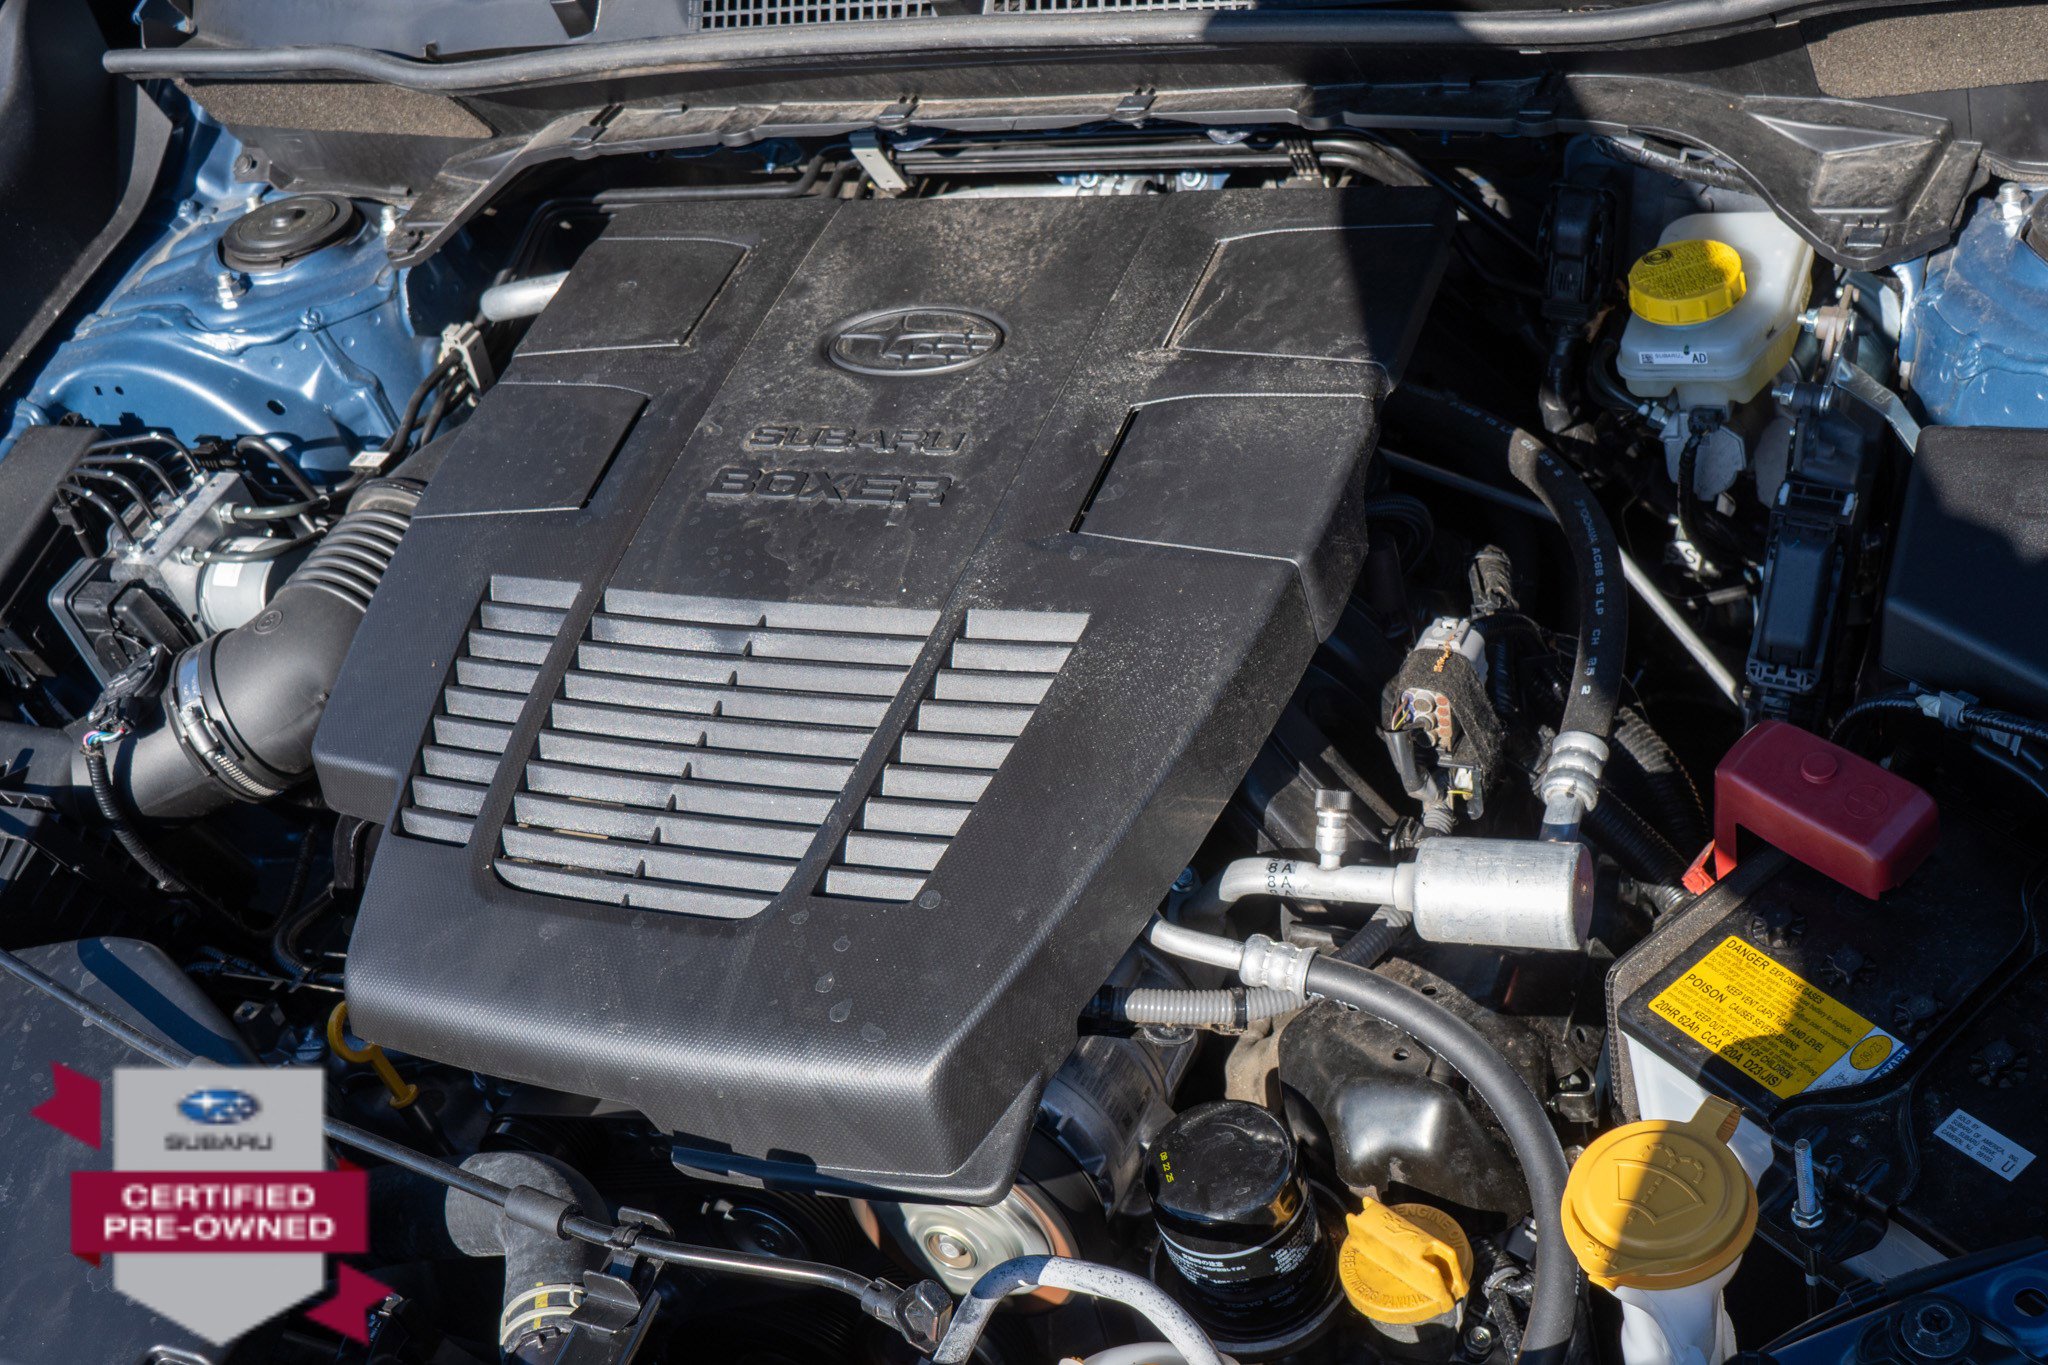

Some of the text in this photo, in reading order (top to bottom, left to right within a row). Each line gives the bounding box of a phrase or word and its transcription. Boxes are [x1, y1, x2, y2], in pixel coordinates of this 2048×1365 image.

[1692, 353, 1707, 364] AD
[749, 426, 968, 455] SUBARU
[1520, 438, 1536, 450] CH
[705, 467, 953, 507] BOXER
[1590, 628, 1601, 647] CH
[1580, 684, 1592, 696] 2
[1725, 939, 1825, 1004] DANGER EXPLOSIVE GASES
[1684, 973, 1727, 1003] POISON
[1727, 1002, 1755, 1021] CAUSES
[1751, 1017, 1779, 1037] SEVERE
[1774, 1033, 1800, 1051] BURNS
[1723, 983, 1826, 1052] KEEP VENT CAPS TIGHT AND LEVEL
[1654, 999, 1681, 1019] 20HR
[1675, 1014, 1702, 1033] 62Ah
[1699, 1030, 1724, 1048] CCA
[1718, 1043, 1745, 1062] 620A
[1741, 1058, 1784, 1088] D23(JIS)
[1692, 1009, 1711, 1023] KEEP
[1707, 1020, 1724, 1032] OUT
[1720, 1028, 1733, 1038] OF
[1729, 1034, 1754, 1052] REACH
[1750, 1048, 1763, 1058] OF
[1759, 1054, 1793, 1079] CHILDREN
[2001, 1160, 2015, 1173] U
[1396, 1206, 1452, 1230] ENGINE
